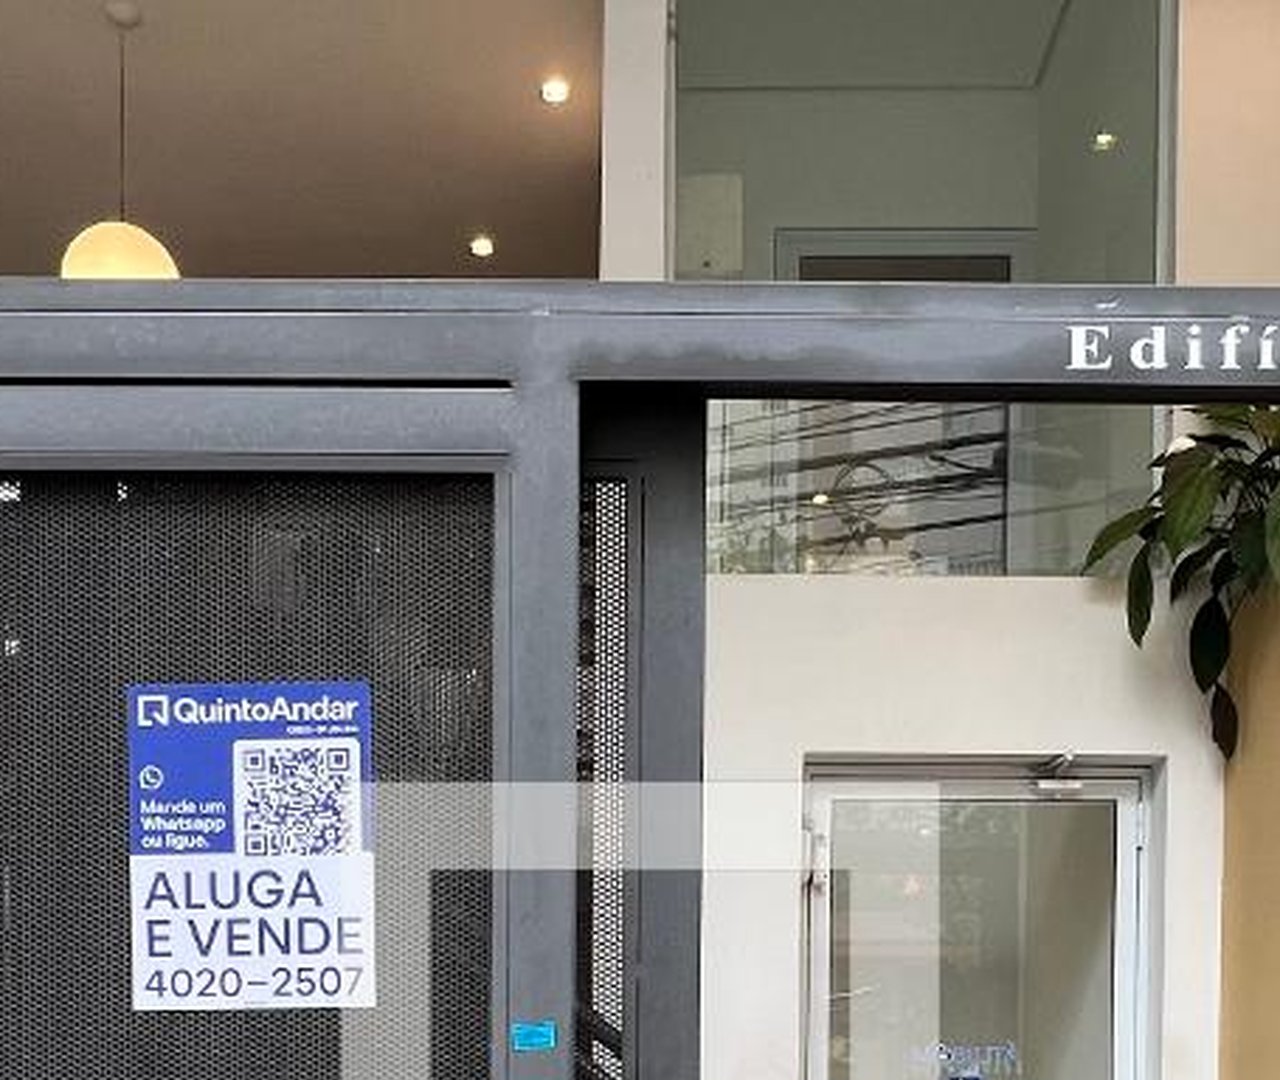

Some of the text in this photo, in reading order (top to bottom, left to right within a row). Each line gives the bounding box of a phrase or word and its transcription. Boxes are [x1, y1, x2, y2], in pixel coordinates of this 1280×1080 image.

[174, 695, 359, 724] QuintoAndar
[199, 801, 226, 814] um
[144, 869, 324, 910] ALUGA
[146, 916, 365, 958] E VENDE
[145, 967, 365, 998] 4020-2507
